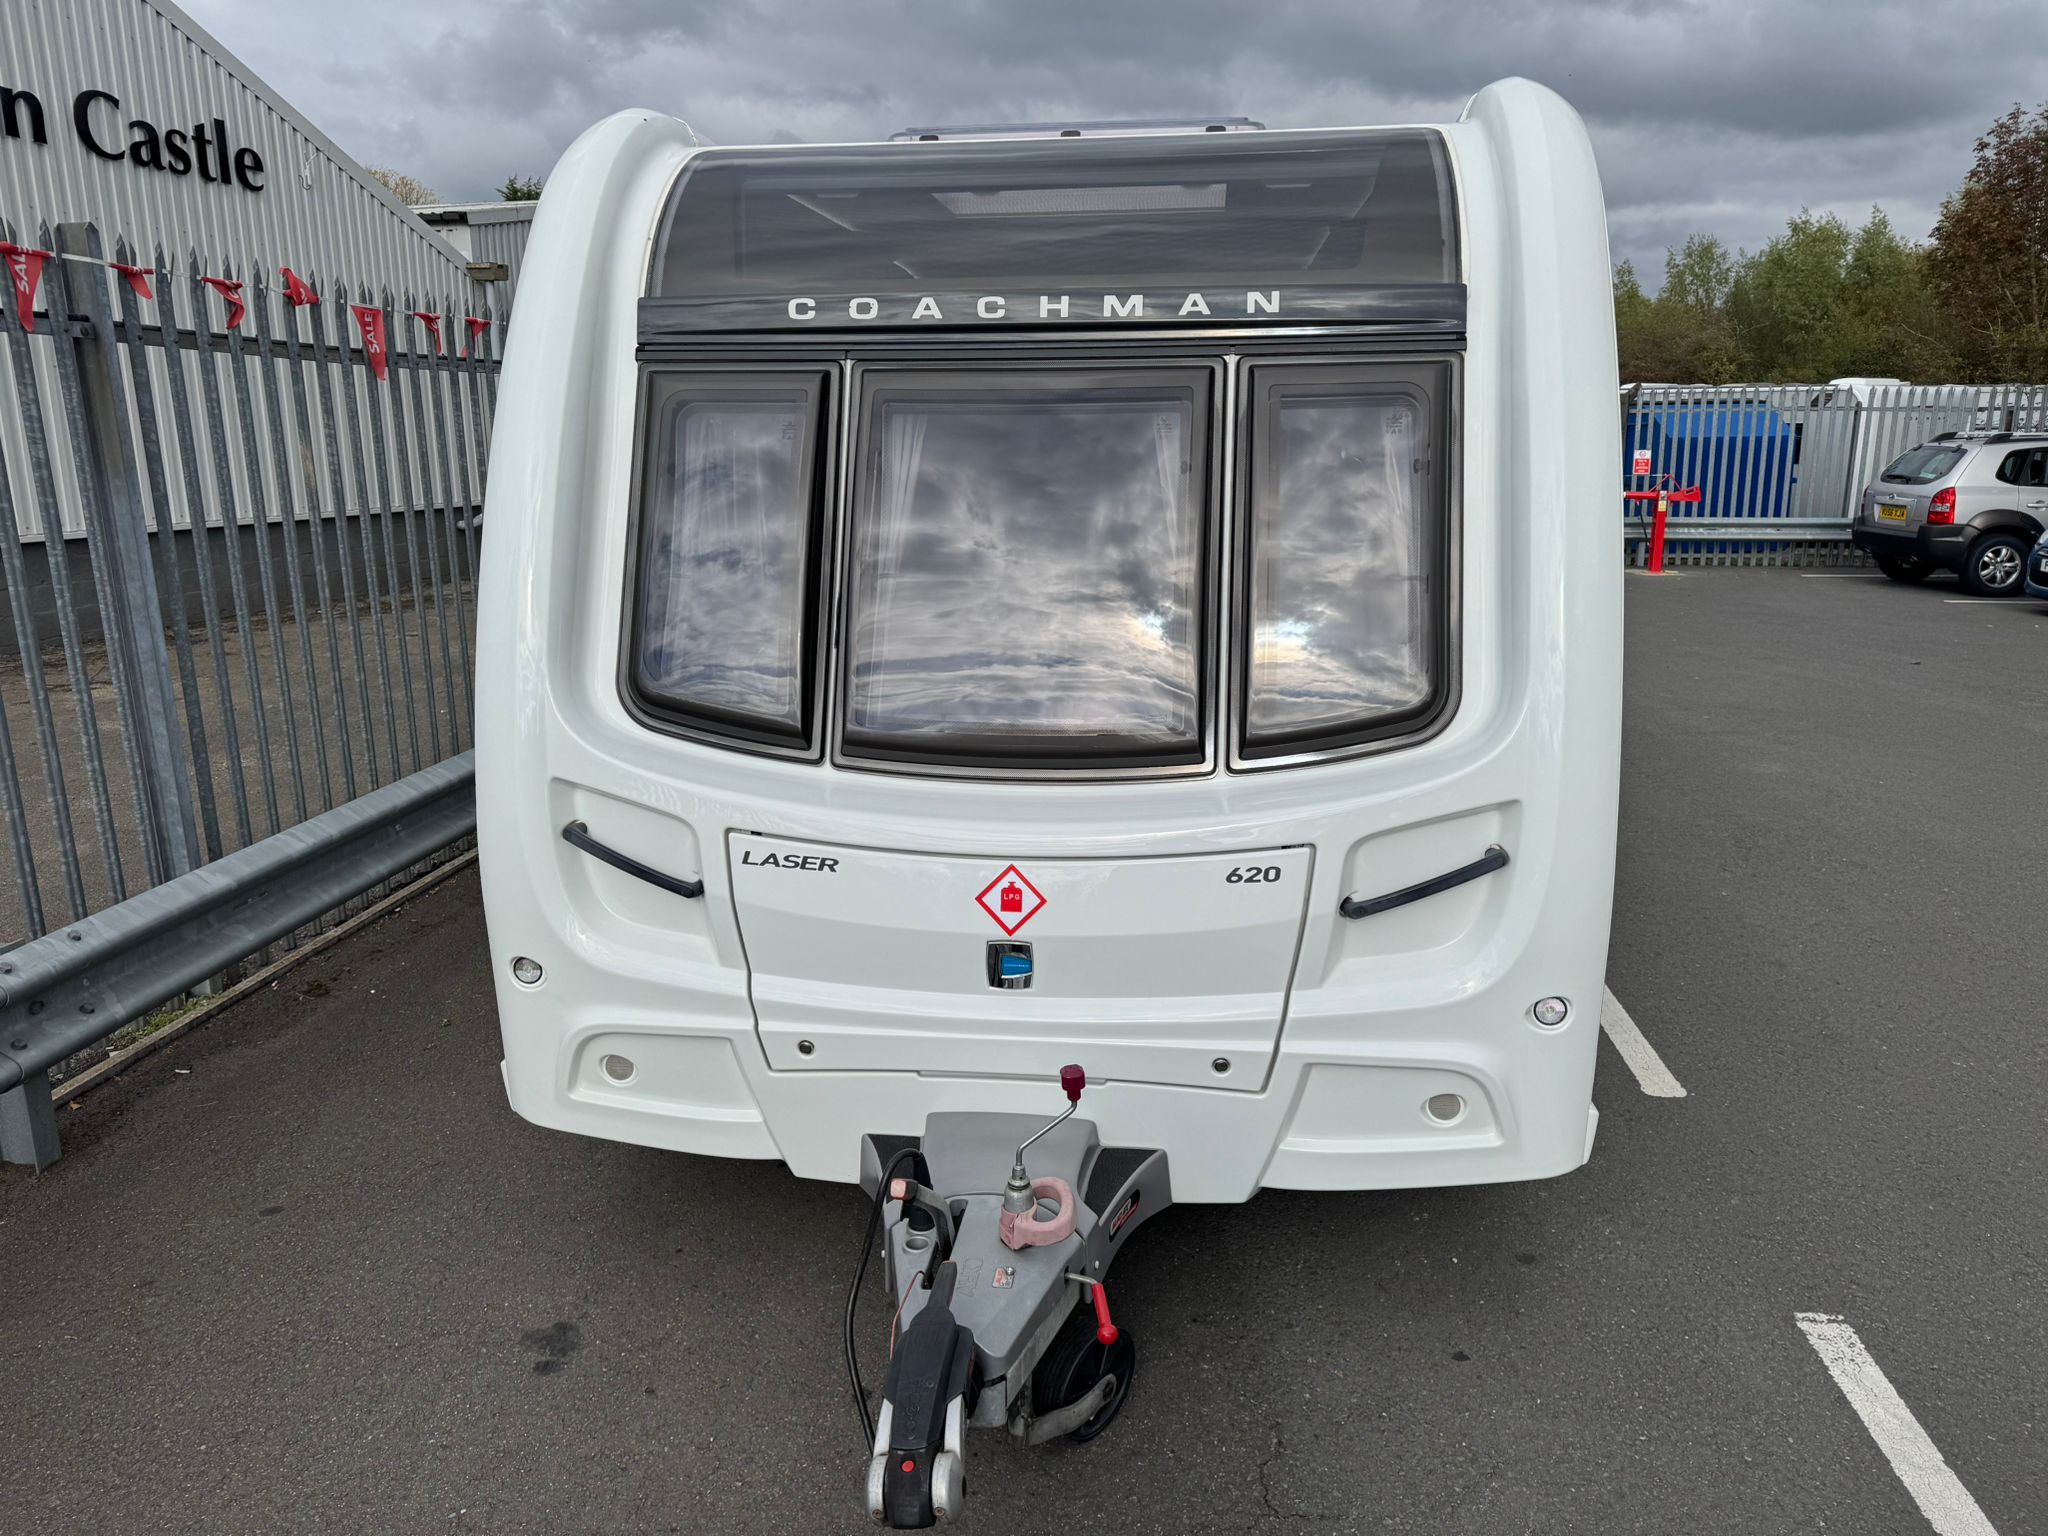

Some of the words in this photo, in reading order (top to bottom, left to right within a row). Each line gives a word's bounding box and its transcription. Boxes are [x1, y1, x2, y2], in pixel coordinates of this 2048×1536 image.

[73, 89, 265, 192] Castle
[788, 290, 1280, 319] COACHMAN
[364, 313, 380, 353] SALE
[742, 851, 839, 872] LASER
[1225, 866, 1281, 884] 620
